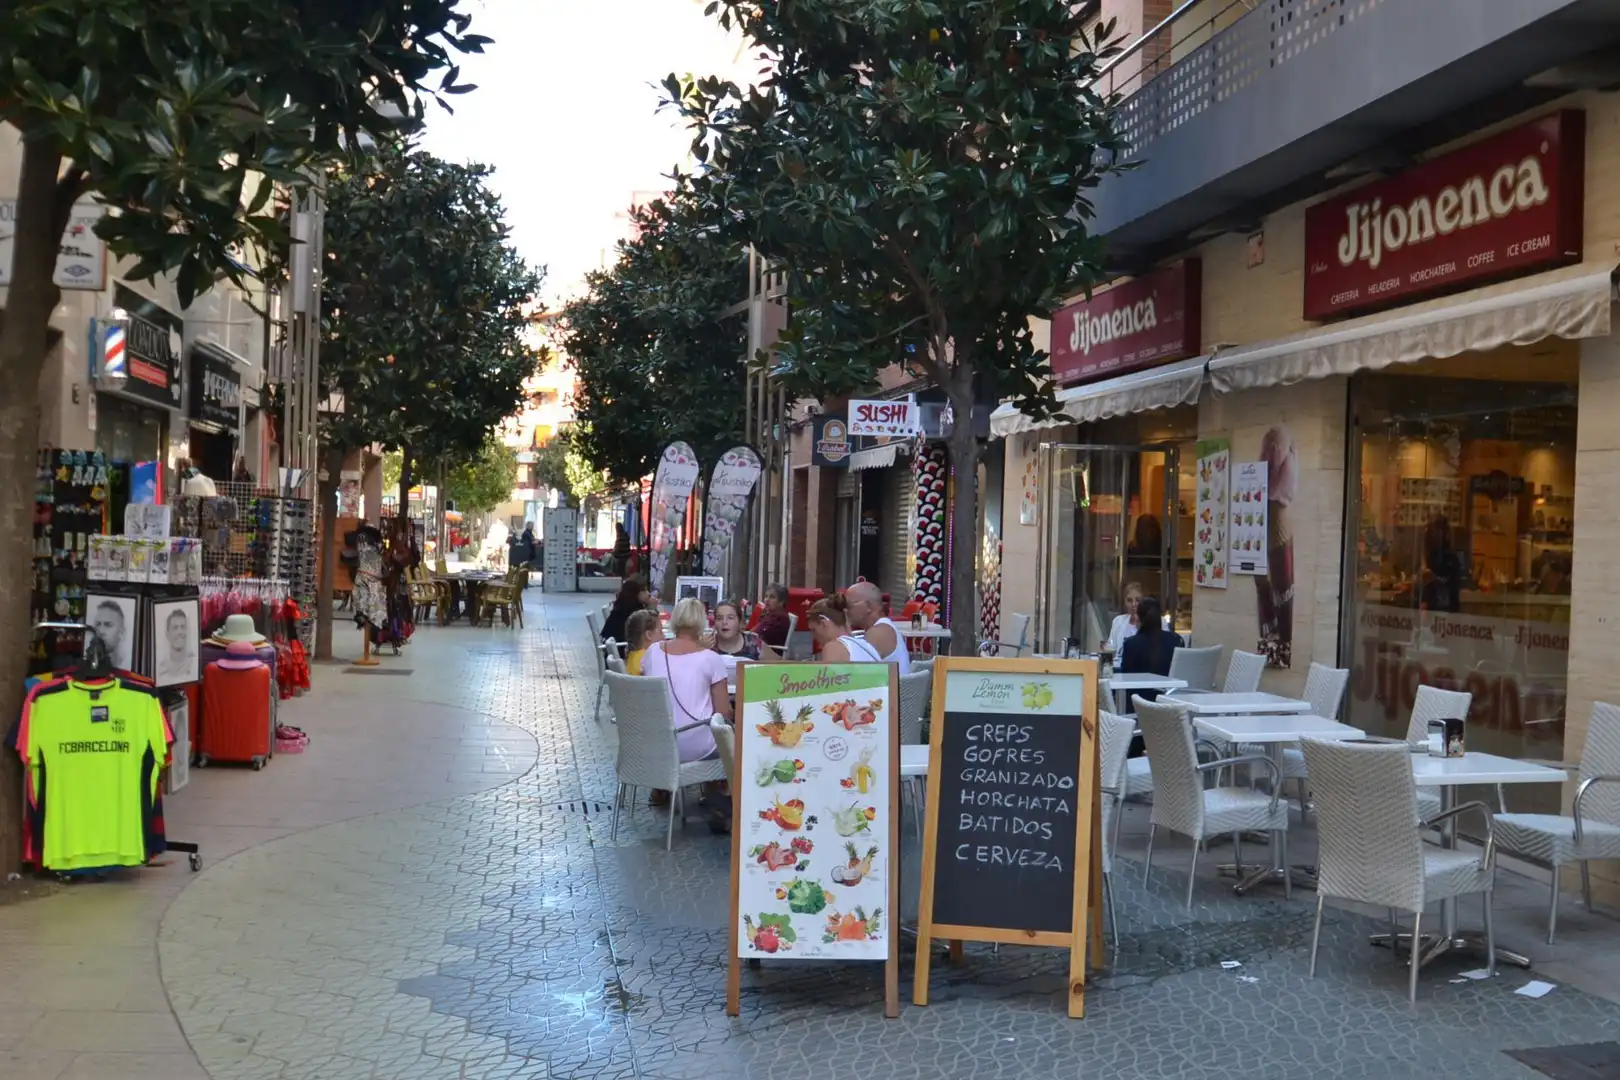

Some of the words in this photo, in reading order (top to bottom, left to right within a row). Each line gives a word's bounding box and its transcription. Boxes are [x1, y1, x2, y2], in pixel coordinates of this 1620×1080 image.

[1337, 156, 1549, 270] Jijonenca
[1330, 288, 1359, 305] CAFETERIA
[1367, 277, 1400, 295] HELADERIA
[1409, 261, 1457, 284] HORCHATERIA
[1467, 250, 1495, 268] COFFEE
[1507, 243, 1520, 257] ICE
[1521, 234, 1551, 254] CREAM
[1069, 296, 1157, 356] Jijonenca
[856, 403, 908, 423] SUSHI
[1431, 615, 1496, 641] Jijonenca
[777, 666, 851, 694] Smoothies
[972, 685, 1010, 699] Lemon
[979, 678, 1014, 691] Damm
[965, 723, 1034, 743] CREPS
[963, 745, 1046, 766] GOFRES
[960, 768, 1074, 789] GRANIZADO
[960, 788, 1070, 815] HORCHATA
[959, 813, 1053, 840] BATIDOS
[955, 843, 1063, 873] CERVEZA
